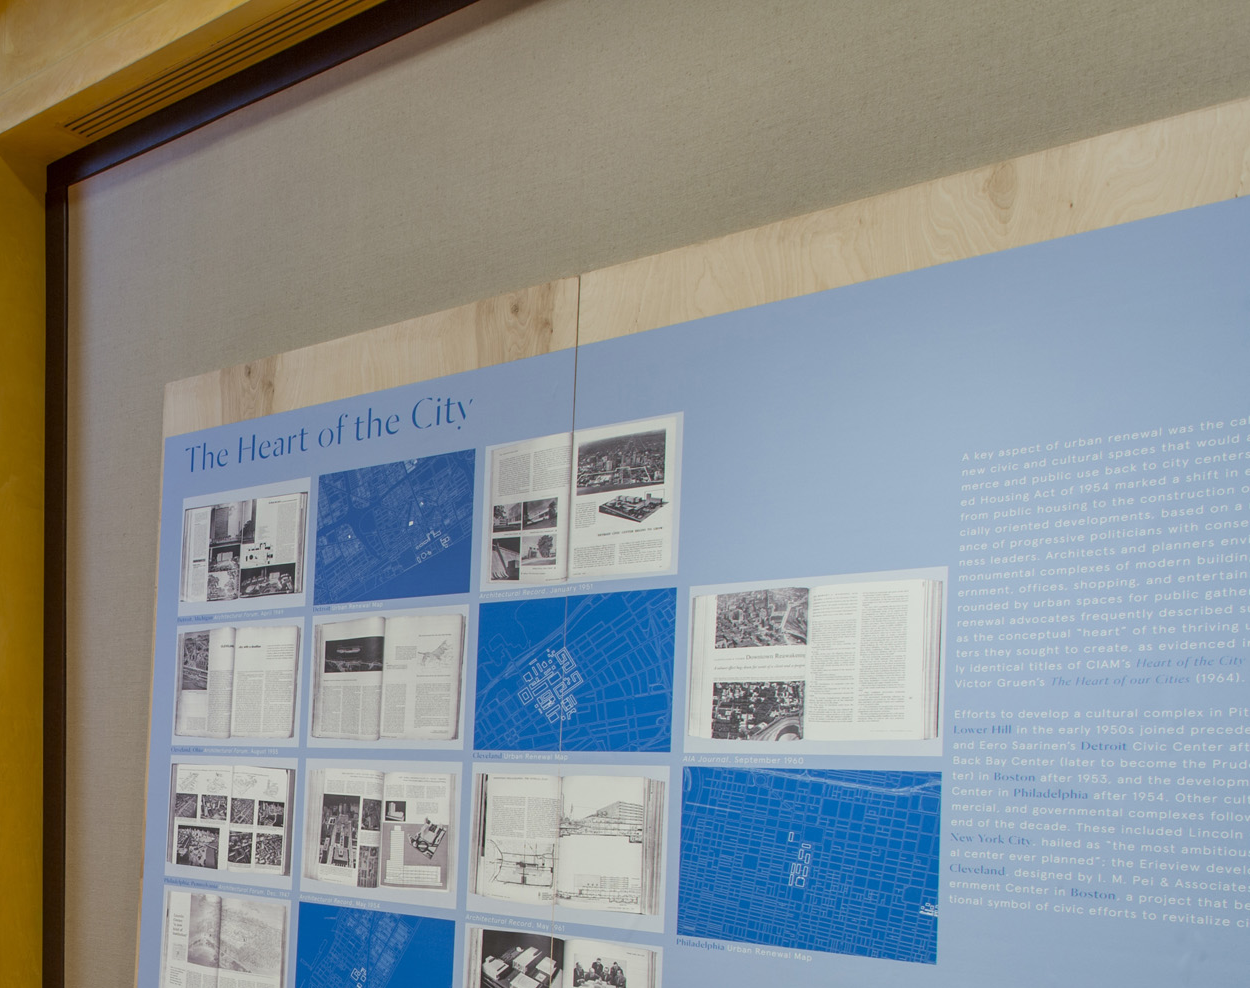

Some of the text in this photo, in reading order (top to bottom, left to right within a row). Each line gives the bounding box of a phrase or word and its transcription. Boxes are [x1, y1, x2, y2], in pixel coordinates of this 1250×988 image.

[185, 397, 473, 472] The Heart of the City
[961, 421, 1224, 461] A key aspect of urban renewal was the
[962, 433, 1239, 476] new civic and cultural spaces that would
[961, 451, 1250, 491] merce and public use back to city centers
[960, 468, 1238, 506] ed Housing Act of 1954 marked a shift in
[479, 591, 521, 599] Architectural
[550, 585, 577, 594] January
[372, 601, 383, 609] Map
[954, 679, 992, 688] Victor
[997, 677, 1045, 687] Gruen's
[1052, 676, 1071, 686] The
[1075, 676, 1108, 686] Heart
[1113, 675, 1126, 687] of
[1155, 674, 1189, 684] Cities
[1196, 672, 1244, 683] (1964).
[954, 707, 1222, 720] Efforts to develop a cultural complex in
[953, 724, 1184, 736] Lower Hill in the early 1950s joined
[952, 740, 1223, 751] and Eero Saarinen's Detroit Civic Center
[682, 756, 696, 764] AIA
[697, 756, 731, 765] Journal,
[734, 757, 781, 766] September
[299, 894, 333, 903] Architectural
[356, 900, 367, 908] May
[465, 914, 565, 932] Architectural Record, May 961
[676, 938, 812, 962] Philadelphia Urban Renewal Map
